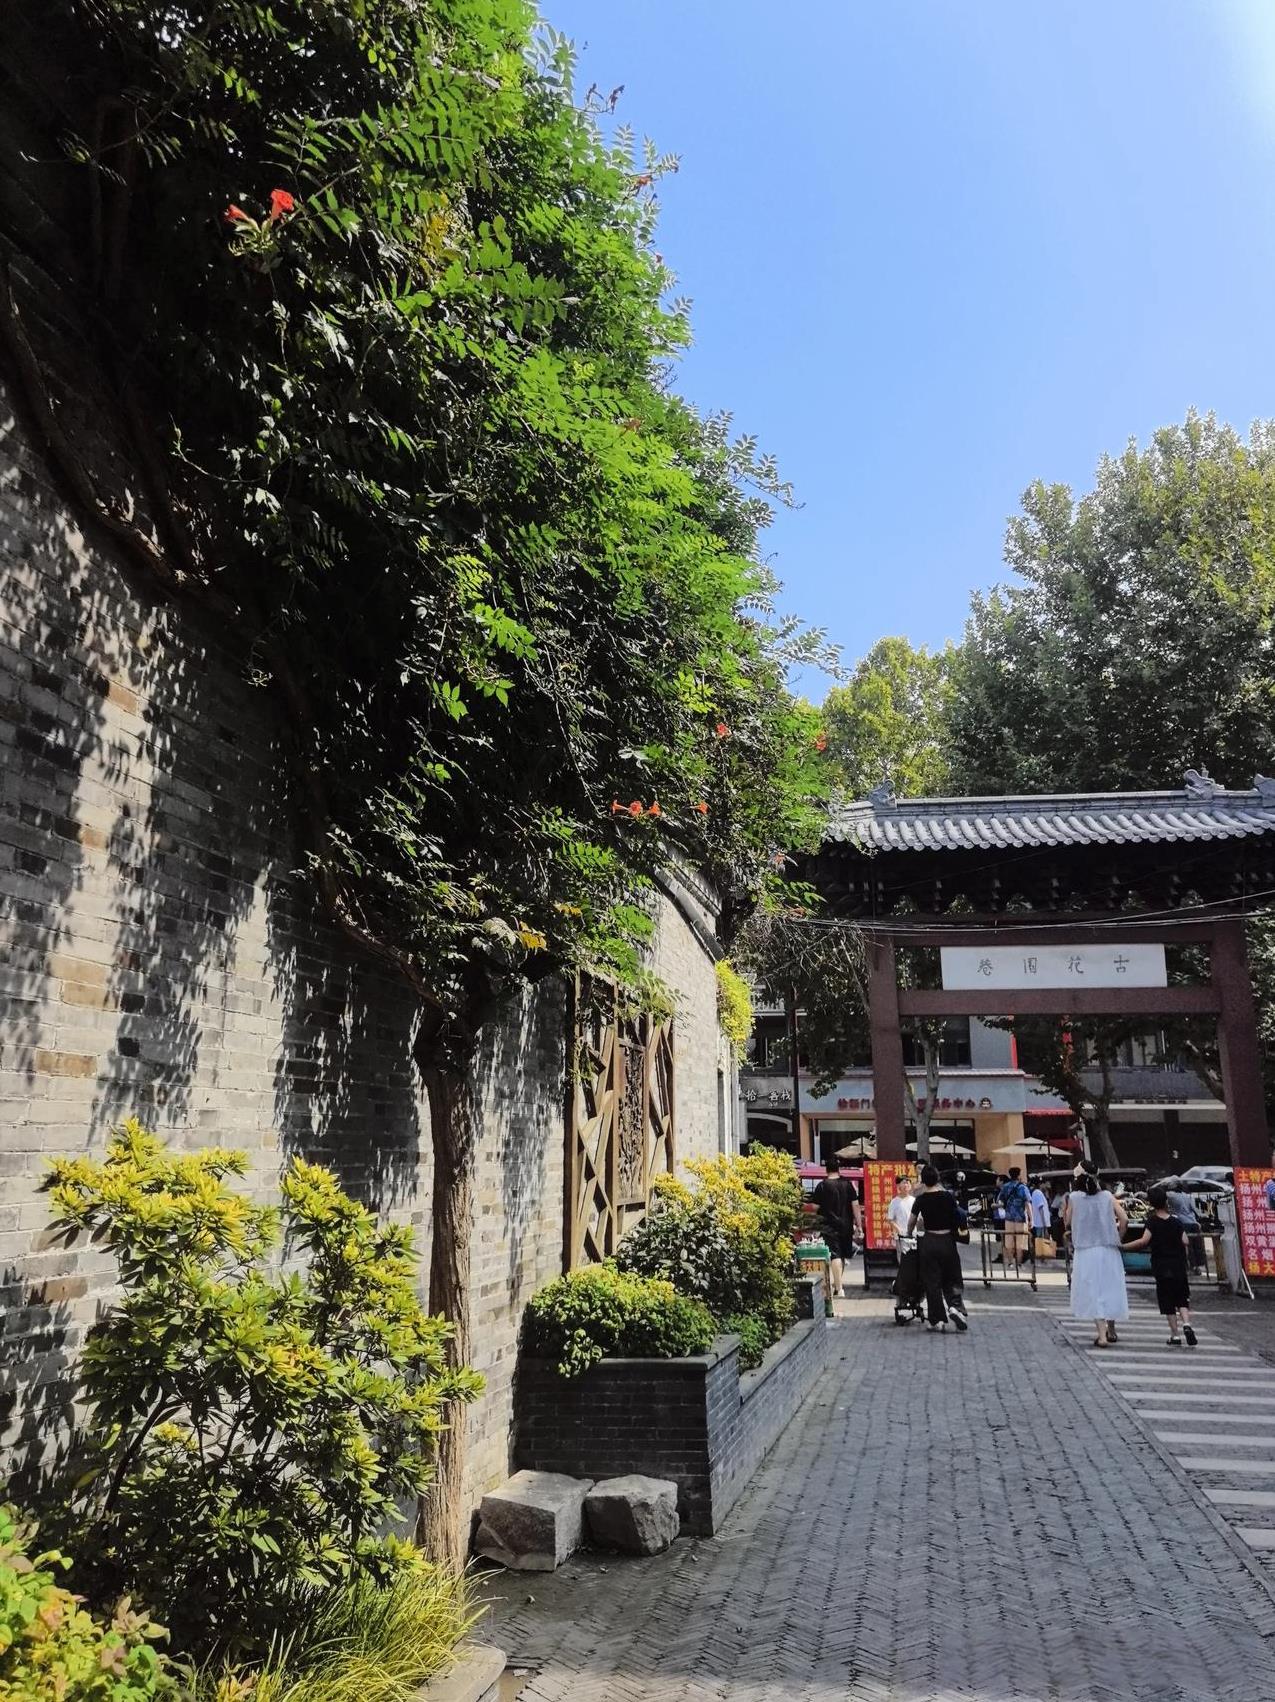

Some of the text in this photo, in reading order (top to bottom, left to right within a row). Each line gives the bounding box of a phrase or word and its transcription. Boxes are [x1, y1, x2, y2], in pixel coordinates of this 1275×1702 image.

[1238, 1170, 1275, 1182] 土特产
[1240, 1183, 1267, 1195] 扬州
